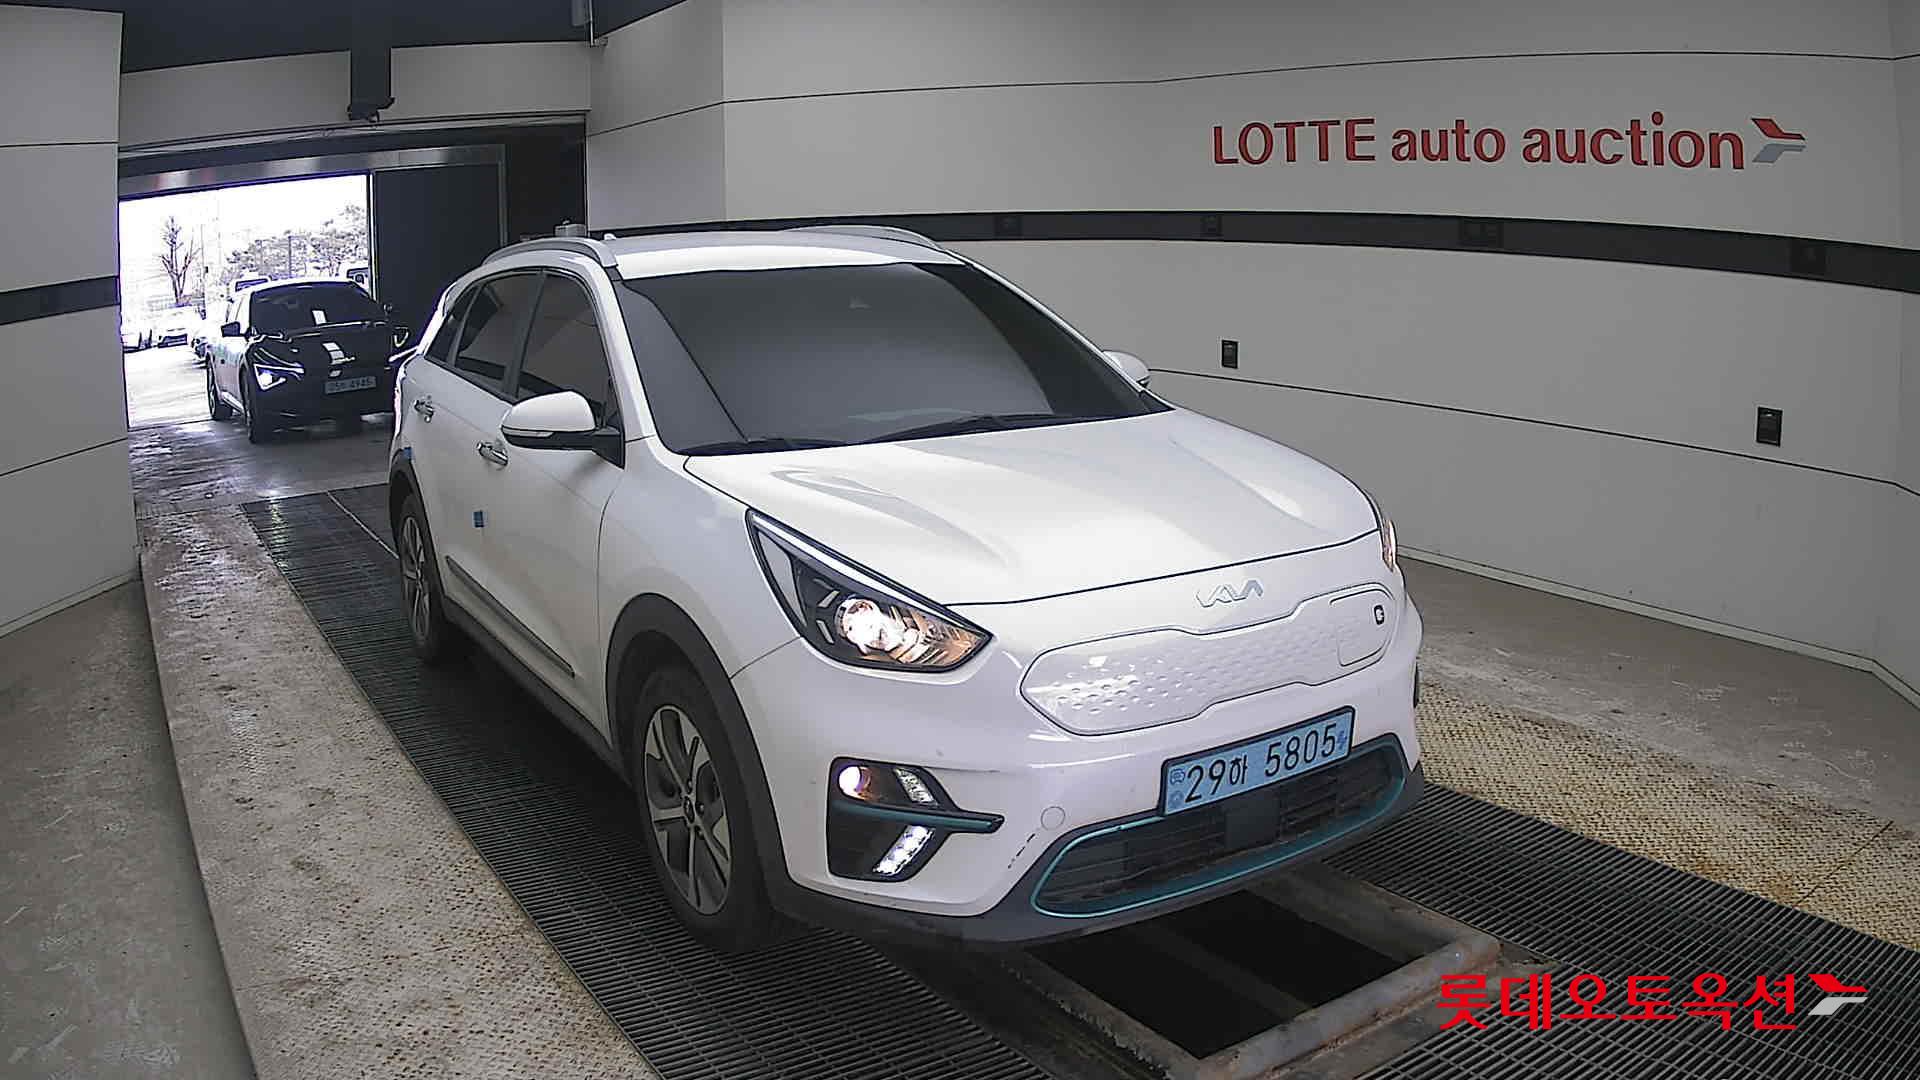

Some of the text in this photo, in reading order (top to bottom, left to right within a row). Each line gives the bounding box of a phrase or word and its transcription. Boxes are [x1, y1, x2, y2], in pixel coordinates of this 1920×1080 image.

[1213, 112, 1744, 169] LOTTE auto auction
[1184, 723, 1337, 803] 29하 5805
